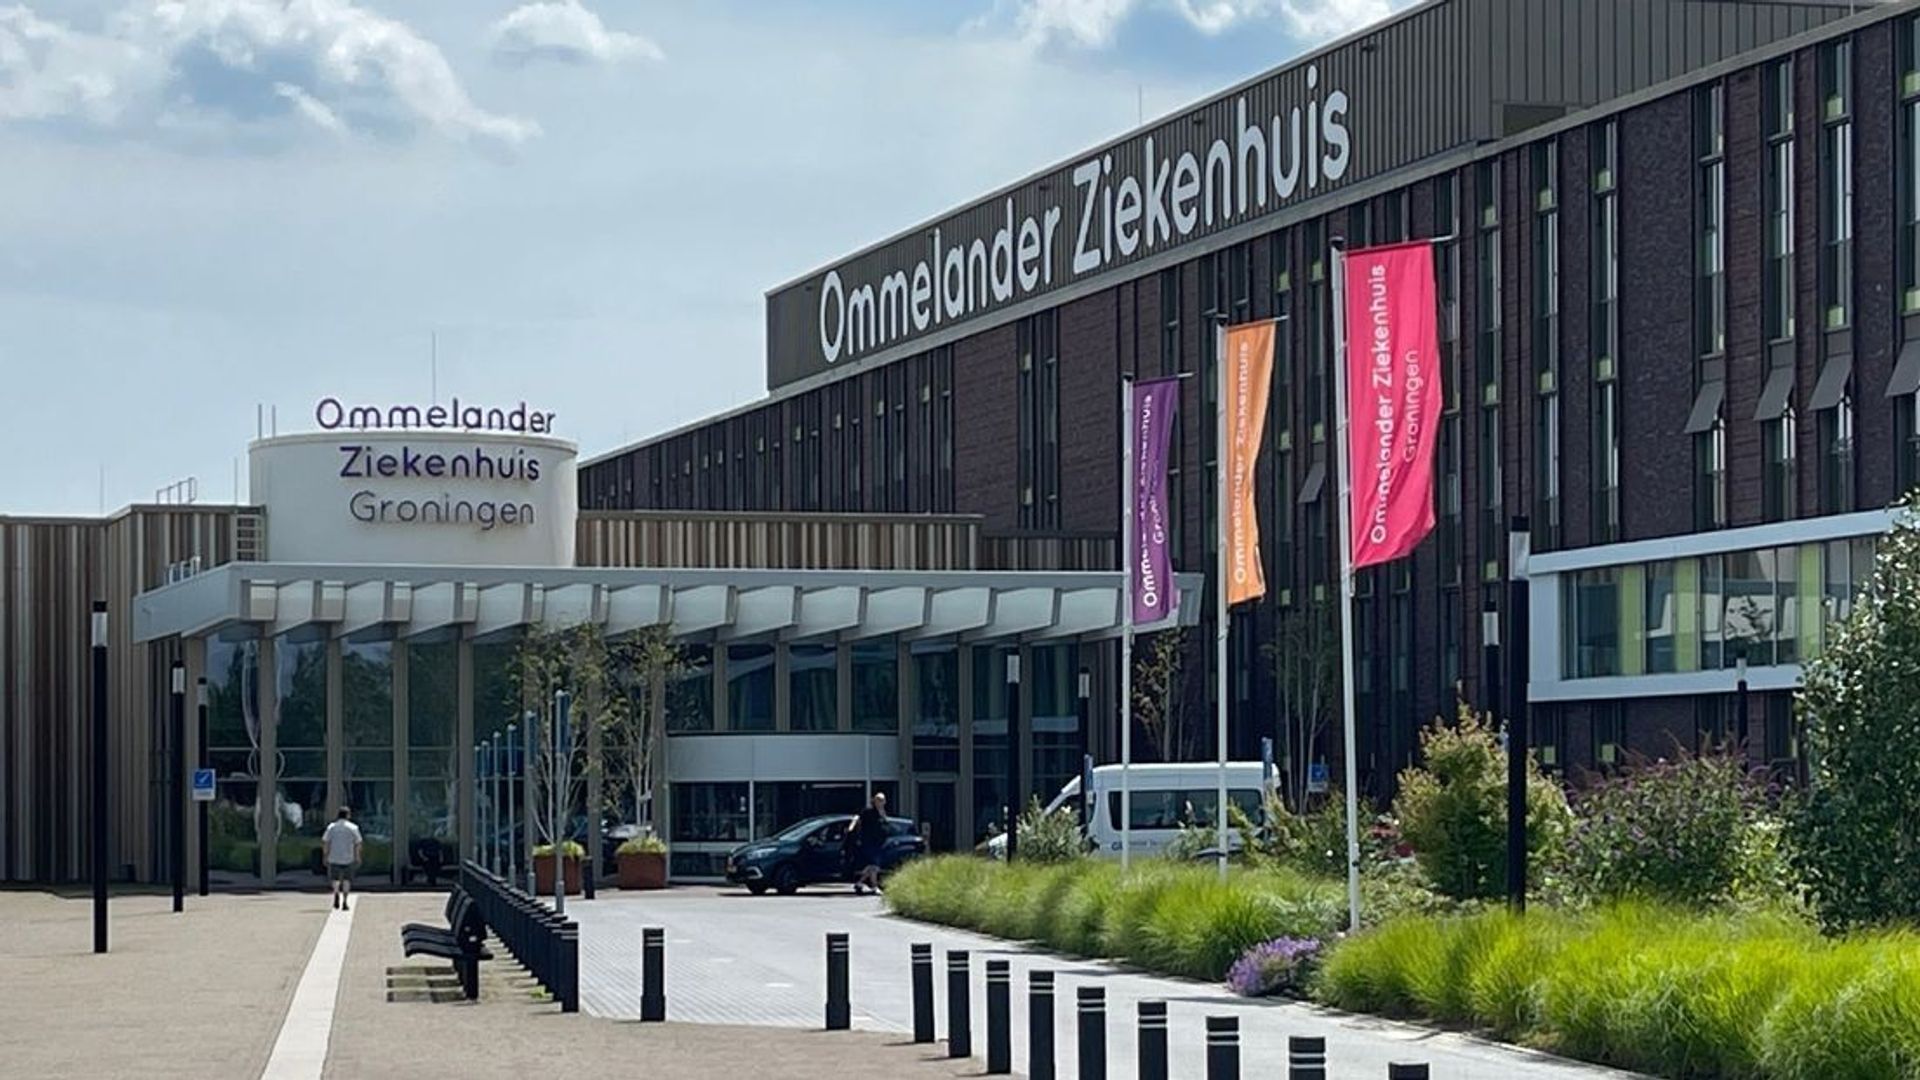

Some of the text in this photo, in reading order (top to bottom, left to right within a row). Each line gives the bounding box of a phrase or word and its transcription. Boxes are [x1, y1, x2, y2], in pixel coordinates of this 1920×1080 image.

[818, 64, 1351, 364] Ommelander Ziekenhuis
[316, 397, 556, 434] Ommelander
[1368, 264, 1394, 544] Ommelander Ziekenhuis
[1403, 351, 1424, 463] Groningen
[340, 446, 540, 481] Ziekenhuis
[350, 490, 535, 531] Groningen
[1233, 454, 1248, 585] Ommelander
